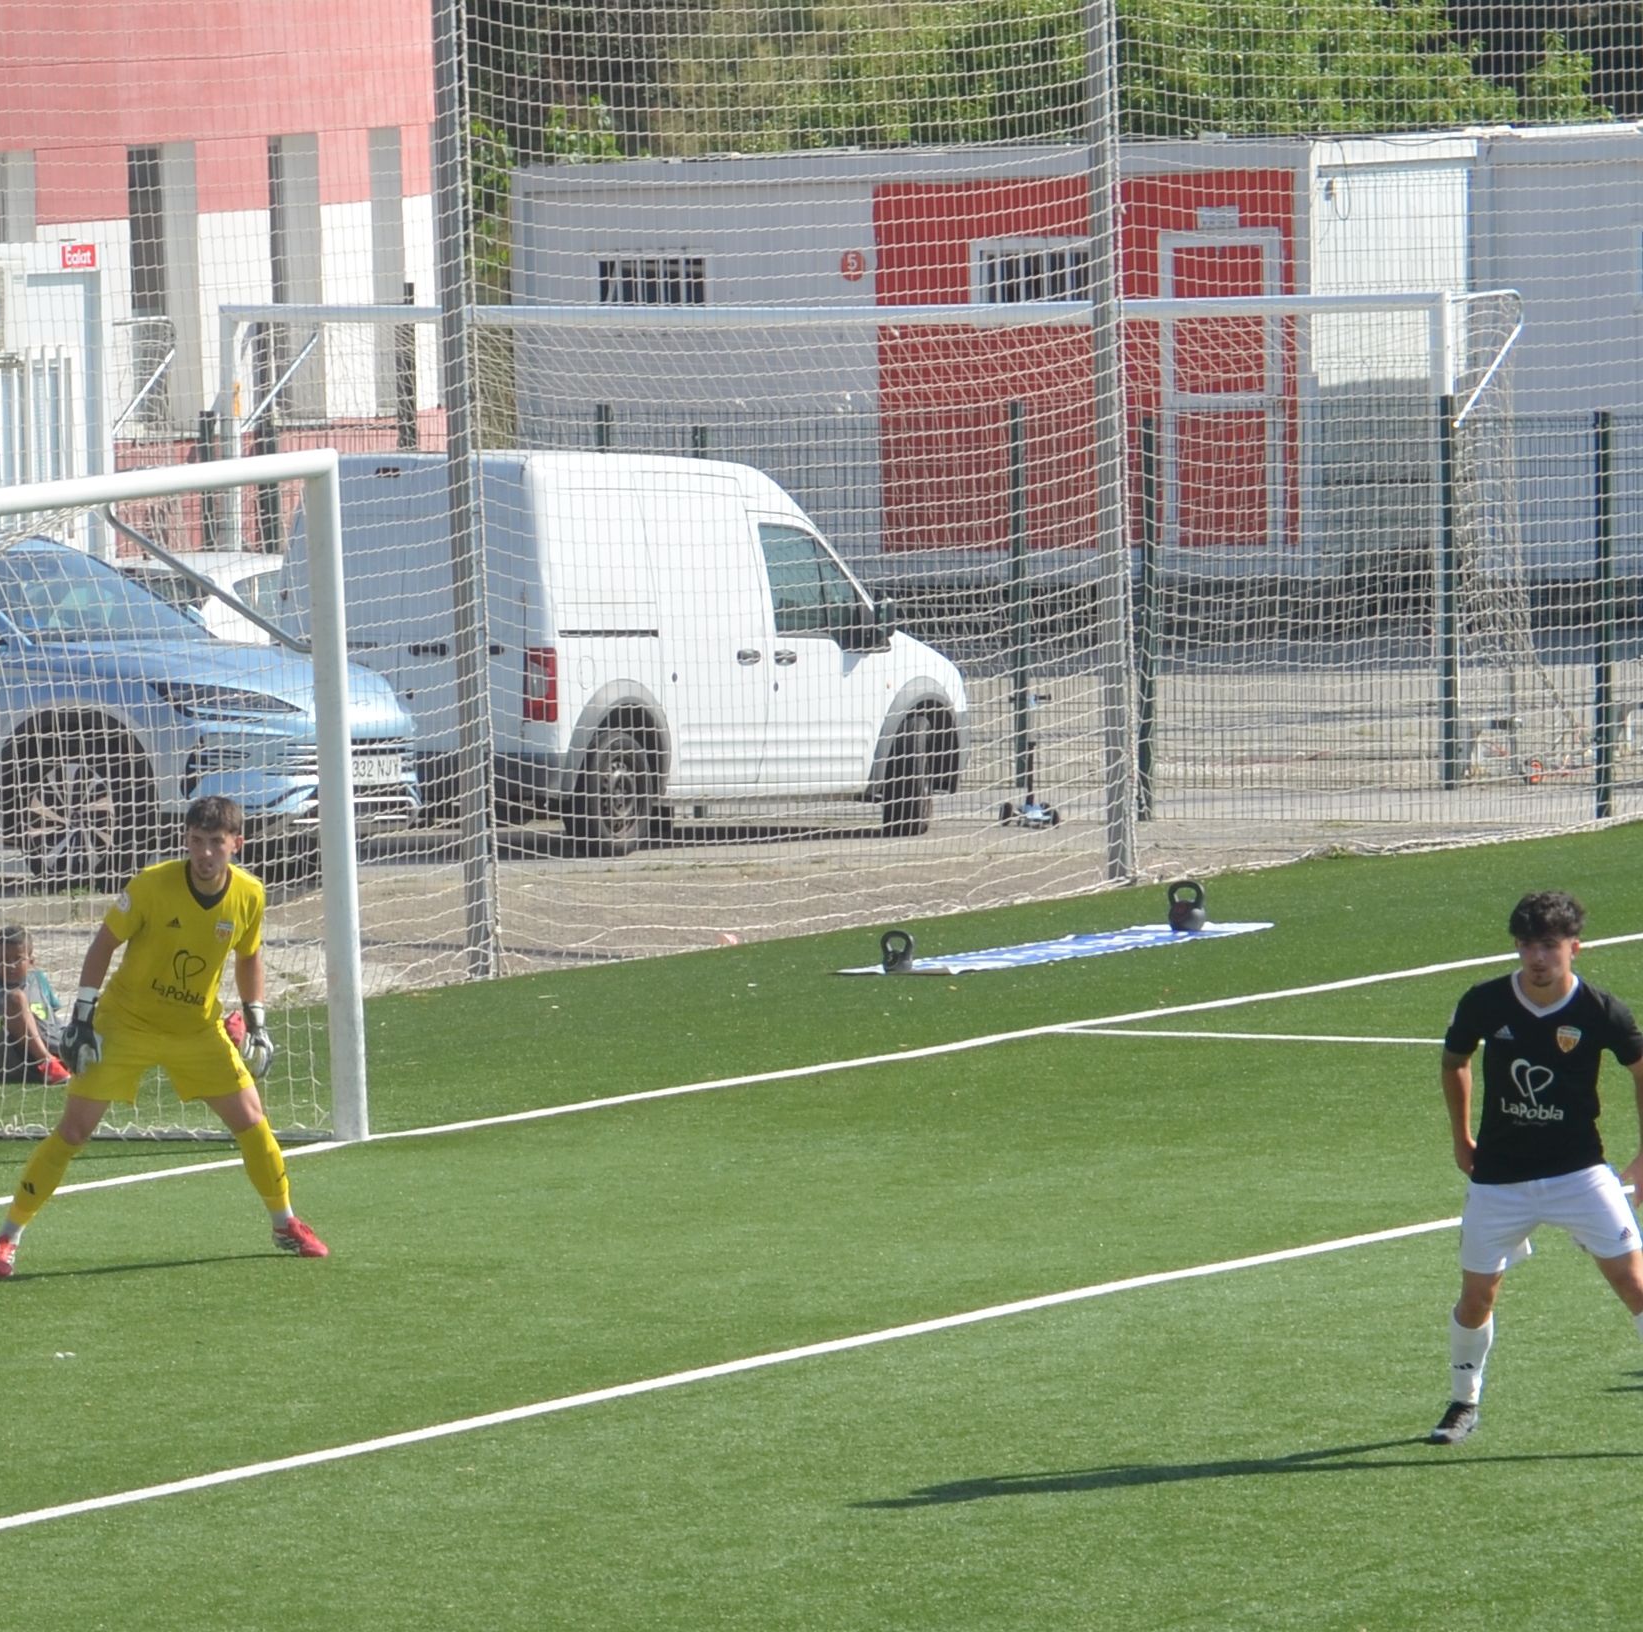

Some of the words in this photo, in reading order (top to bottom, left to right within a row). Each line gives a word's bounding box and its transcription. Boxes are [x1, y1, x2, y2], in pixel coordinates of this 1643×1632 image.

[847, 253, 857, 270] 5
[352, 760, 374, 777] 332
[1501, 1097, 1564, 1121] LaPobla
